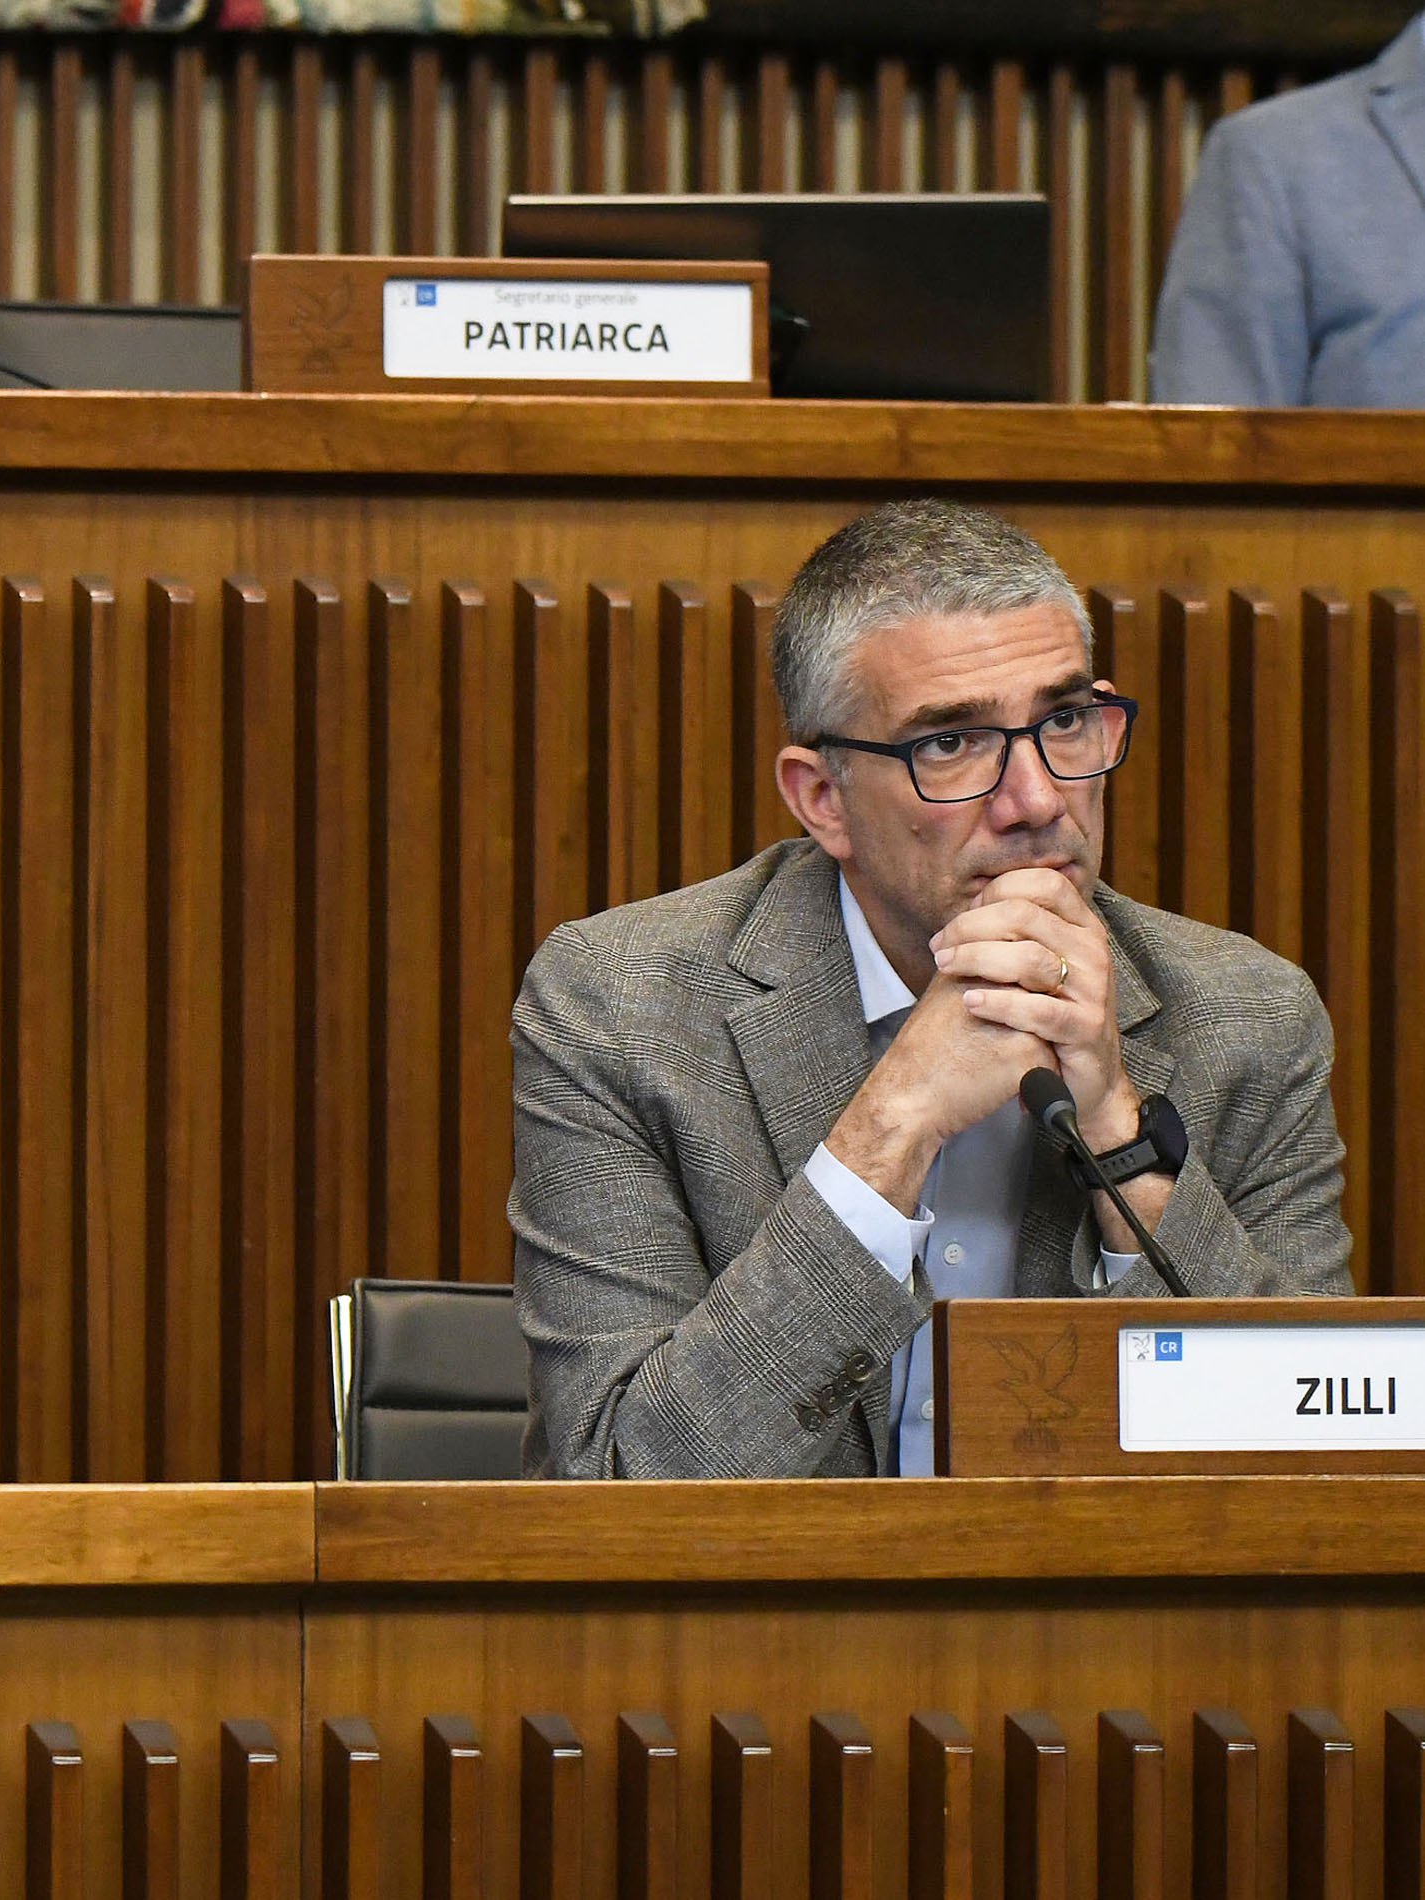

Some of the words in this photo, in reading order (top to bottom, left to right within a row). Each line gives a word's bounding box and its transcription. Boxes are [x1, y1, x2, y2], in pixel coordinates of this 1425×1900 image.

[494, 289, 570, 306] Segretario
[575, 291, 638, 308] generale
[465, 321, 670, 352] PATRIARCA
[1160, 1341, 1177, 1354] CR
[1296, 1377, 1396, 1415] ZILLI
